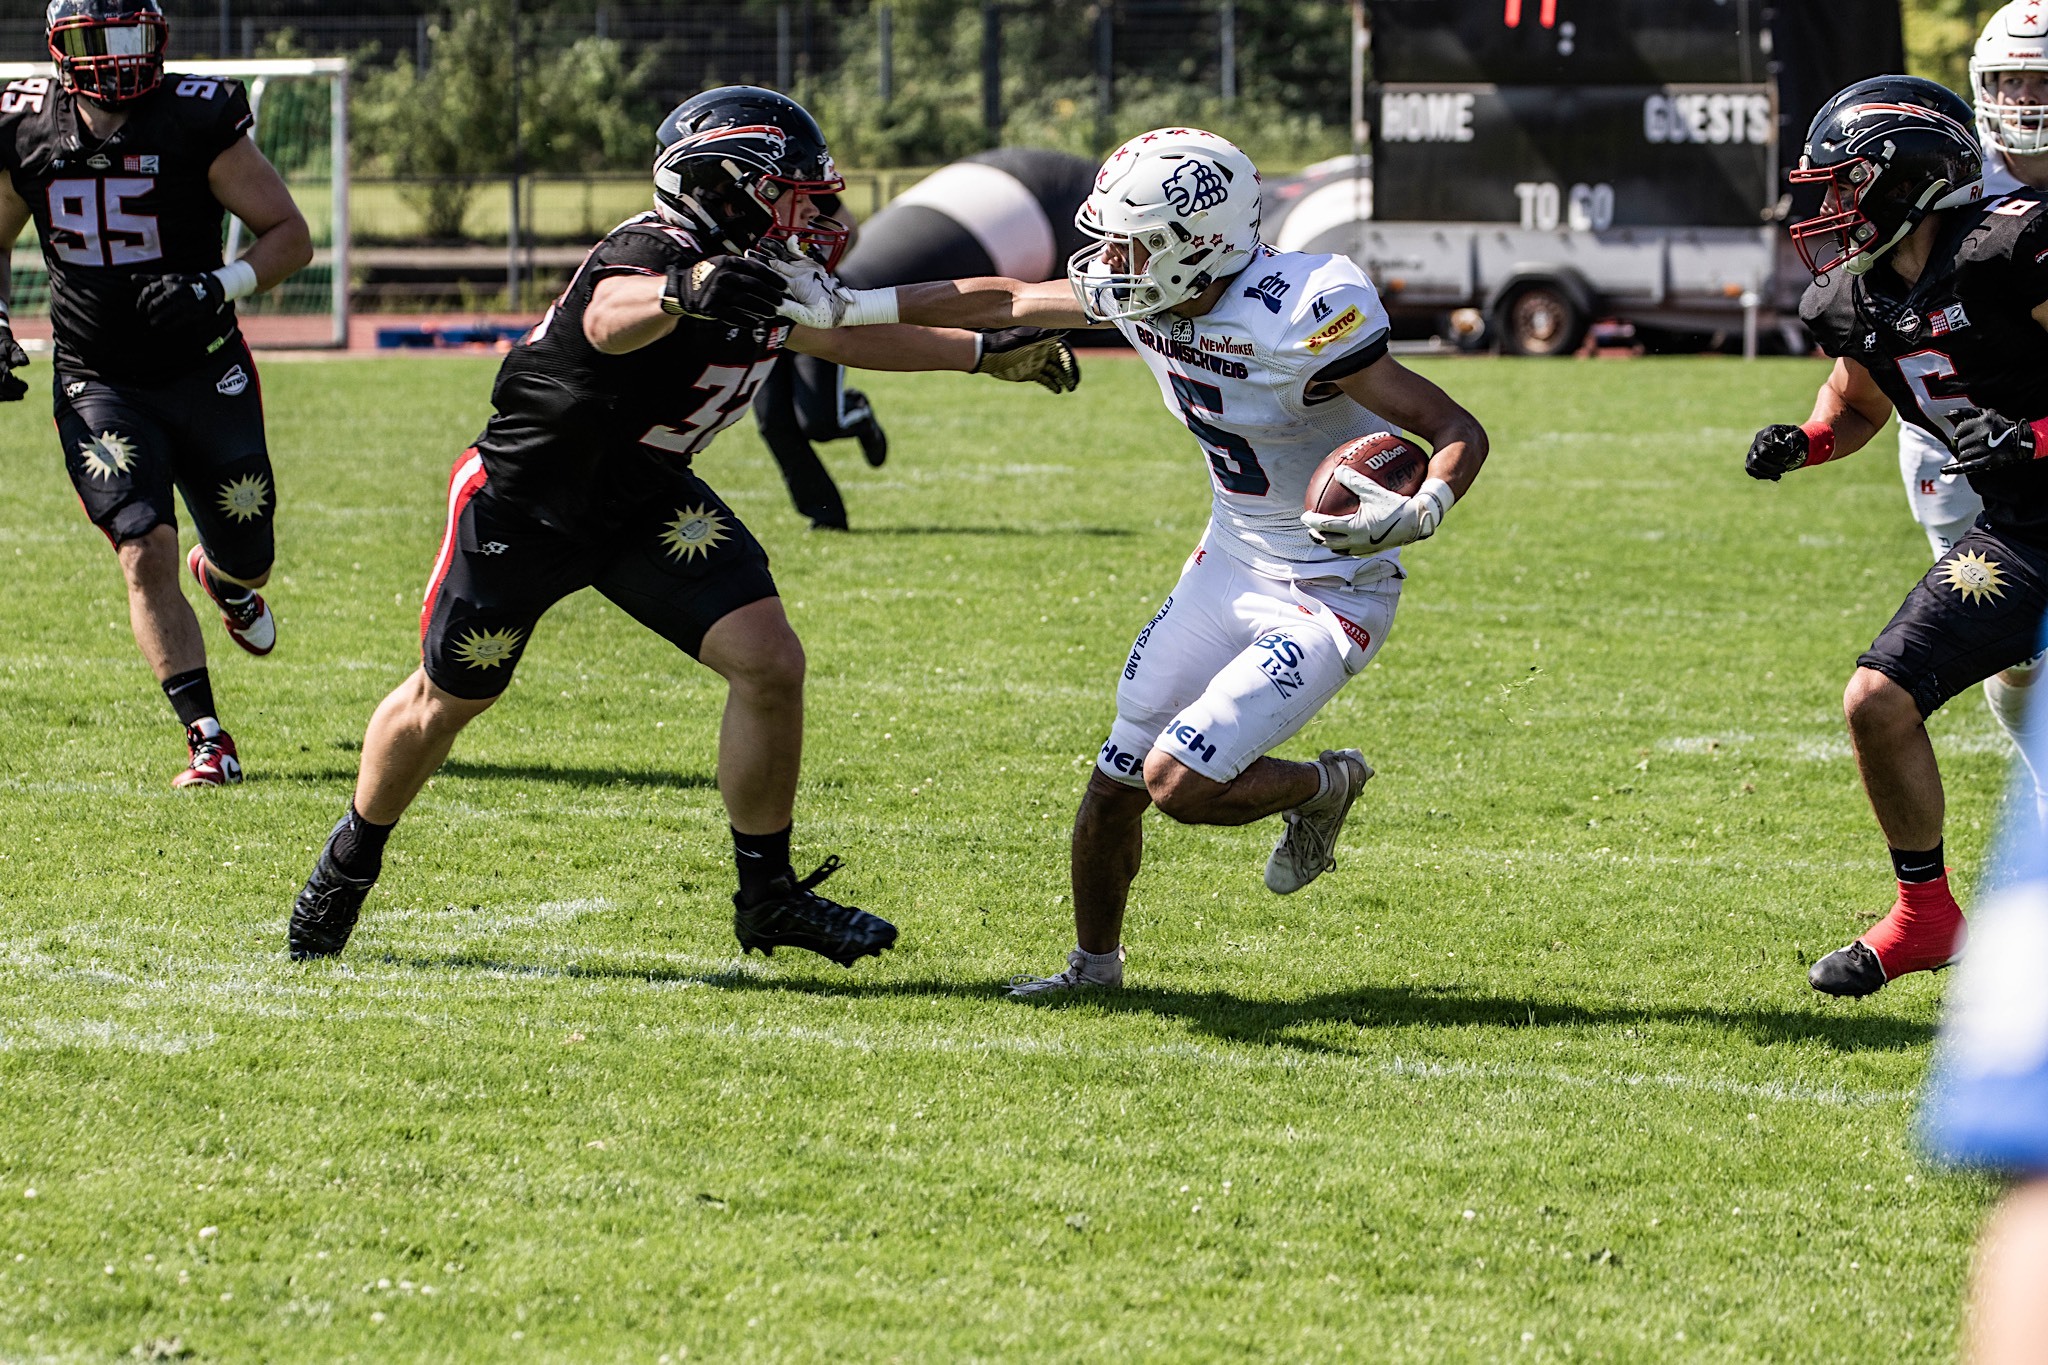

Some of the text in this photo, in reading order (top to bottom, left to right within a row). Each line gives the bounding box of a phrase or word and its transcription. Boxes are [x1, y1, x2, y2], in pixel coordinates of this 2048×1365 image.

[175, 74, 231, 99] 9
[1381, 93, 1475, 142] HOME
[1643, 94, 1770, 144] GUESTS
[46, 178, 163, 266] 95
[1514, 181, 1615, 232] TO GO
[1982, 196, 2041, 216] 6
[1258, 271, 1291, 298] dm
[1321, 311, 1356, 338] LOTTO
[1135, 323, 1248, 380] BRAUNSCHWEIG
[1167, 370, 1271, 497] 5
[1365, 445, 1408, 471] Wilson
[1124, 596, 1174, 681] FITNESSLAND
[1254, 634, 1305, 669] BS
